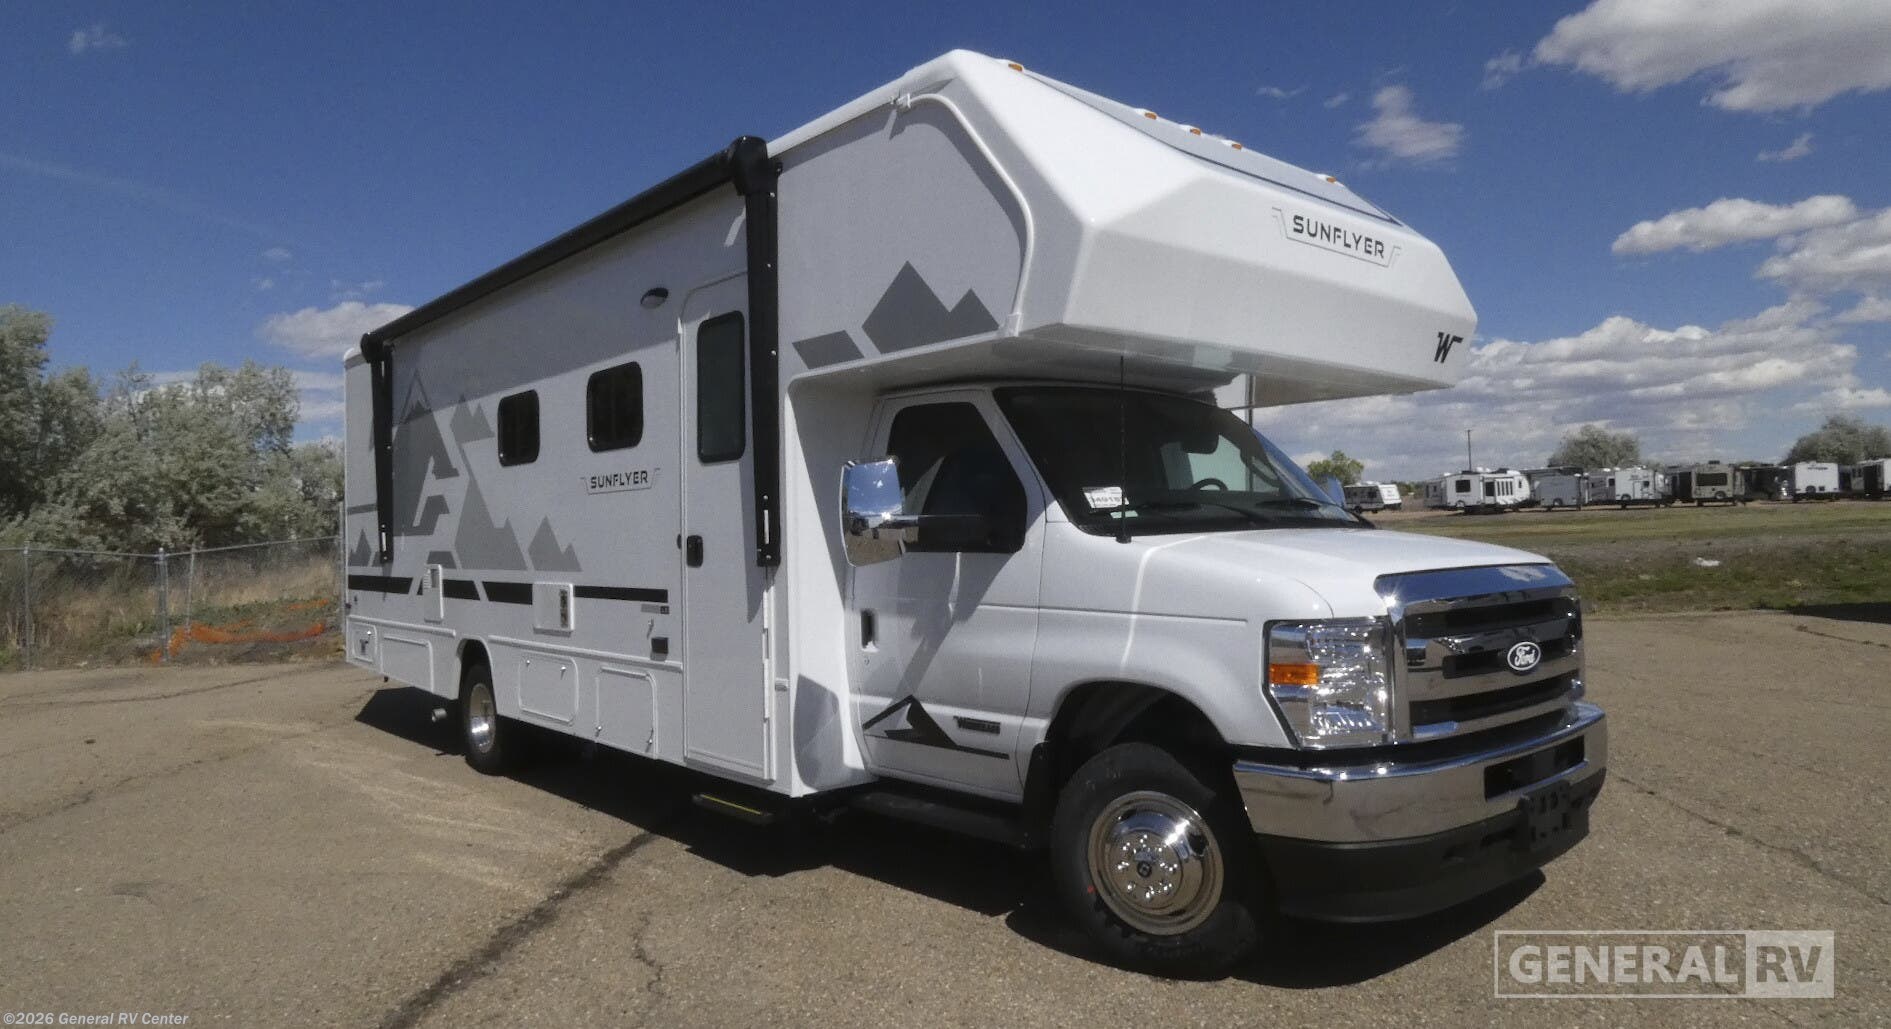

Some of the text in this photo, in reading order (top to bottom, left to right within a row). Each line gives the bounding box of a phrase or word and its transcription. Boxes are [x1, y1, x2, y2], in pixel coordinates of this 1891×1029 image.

[1293, 214, 1385, 259] SUNFLYER
[590, 470, 649, 489] SUNFLYER
[1514, 645, 1536, 667] Ford
